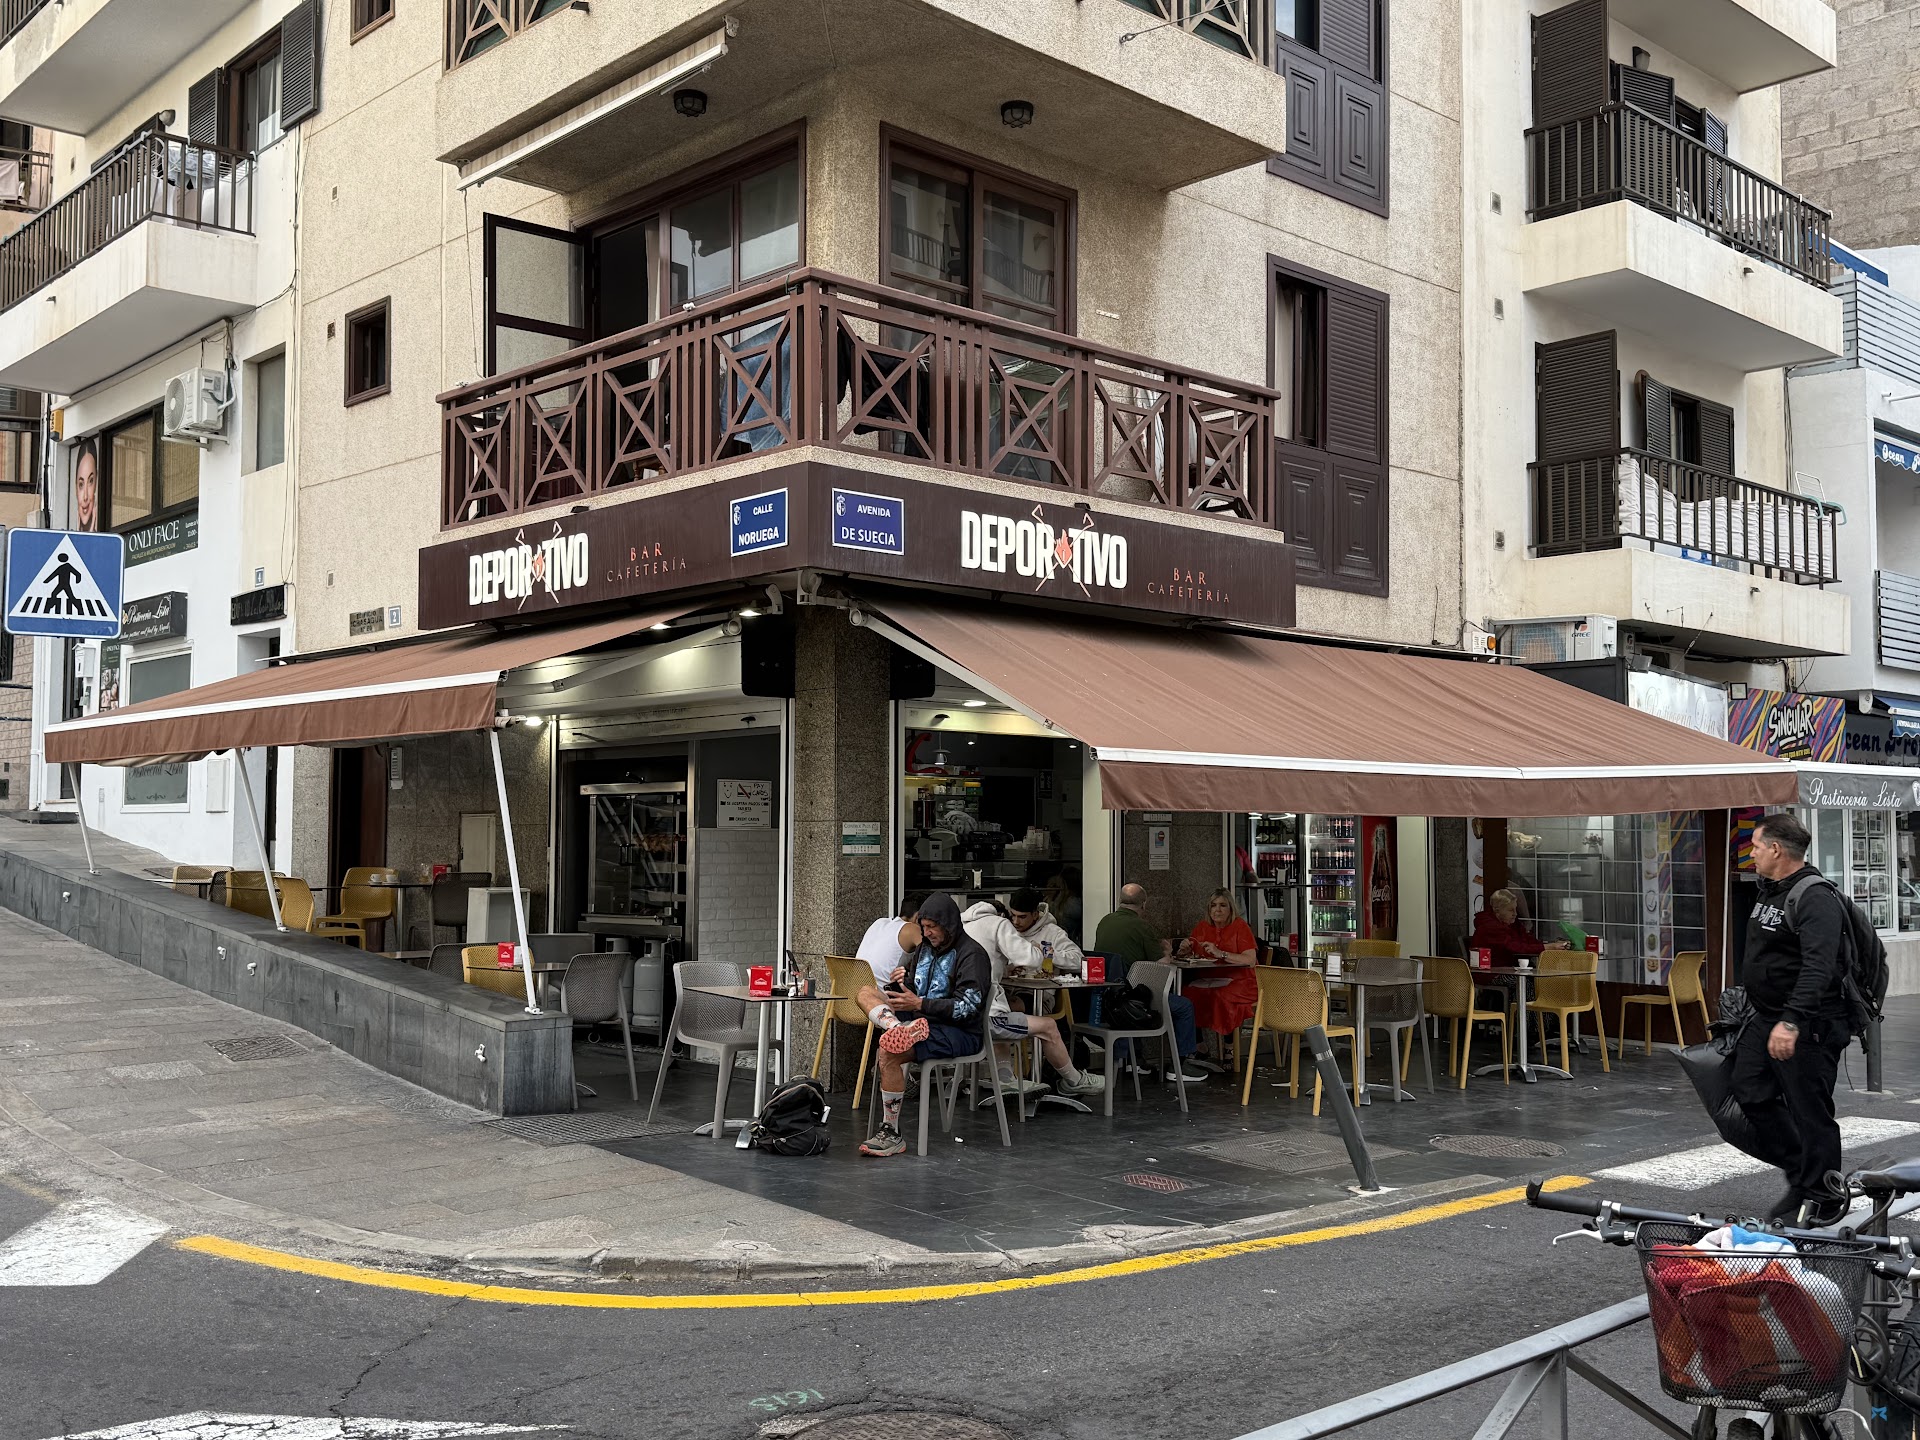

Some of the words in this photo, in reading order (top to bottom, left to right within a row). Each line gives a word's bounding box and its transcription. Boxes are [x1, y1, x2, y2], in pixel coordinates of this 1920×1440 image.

[1882, 443, 1905, 464] Ocean
[753, 503, 773, 516] CALLE
[857, 503, 891, 518] AVENIDA
[129, 528, 154, 552] ONLY
[154, 520, 180, 545] FACE
[738, 526, 779, 546] NORUEGA
[841, 526, 856, 542] DE
[857, 528, 896, 547] SUECIA
[630, 541, 663, 561] BAR
[961, 510, 1128, 590] DEPORTIVO
[469, 532, 590, 606] DEPORTIVO
[606, 557, 688, 583] CAFETERÍA
[1173, 567, 1207, 586] BAR
[1147, 582, 1230, 603] CAFETERÍA
[1846, 732, 1881, 752] cean
[1809, 777, 1868, 807] Pasticceria
[1872, 781, 1903, 808] Lista
